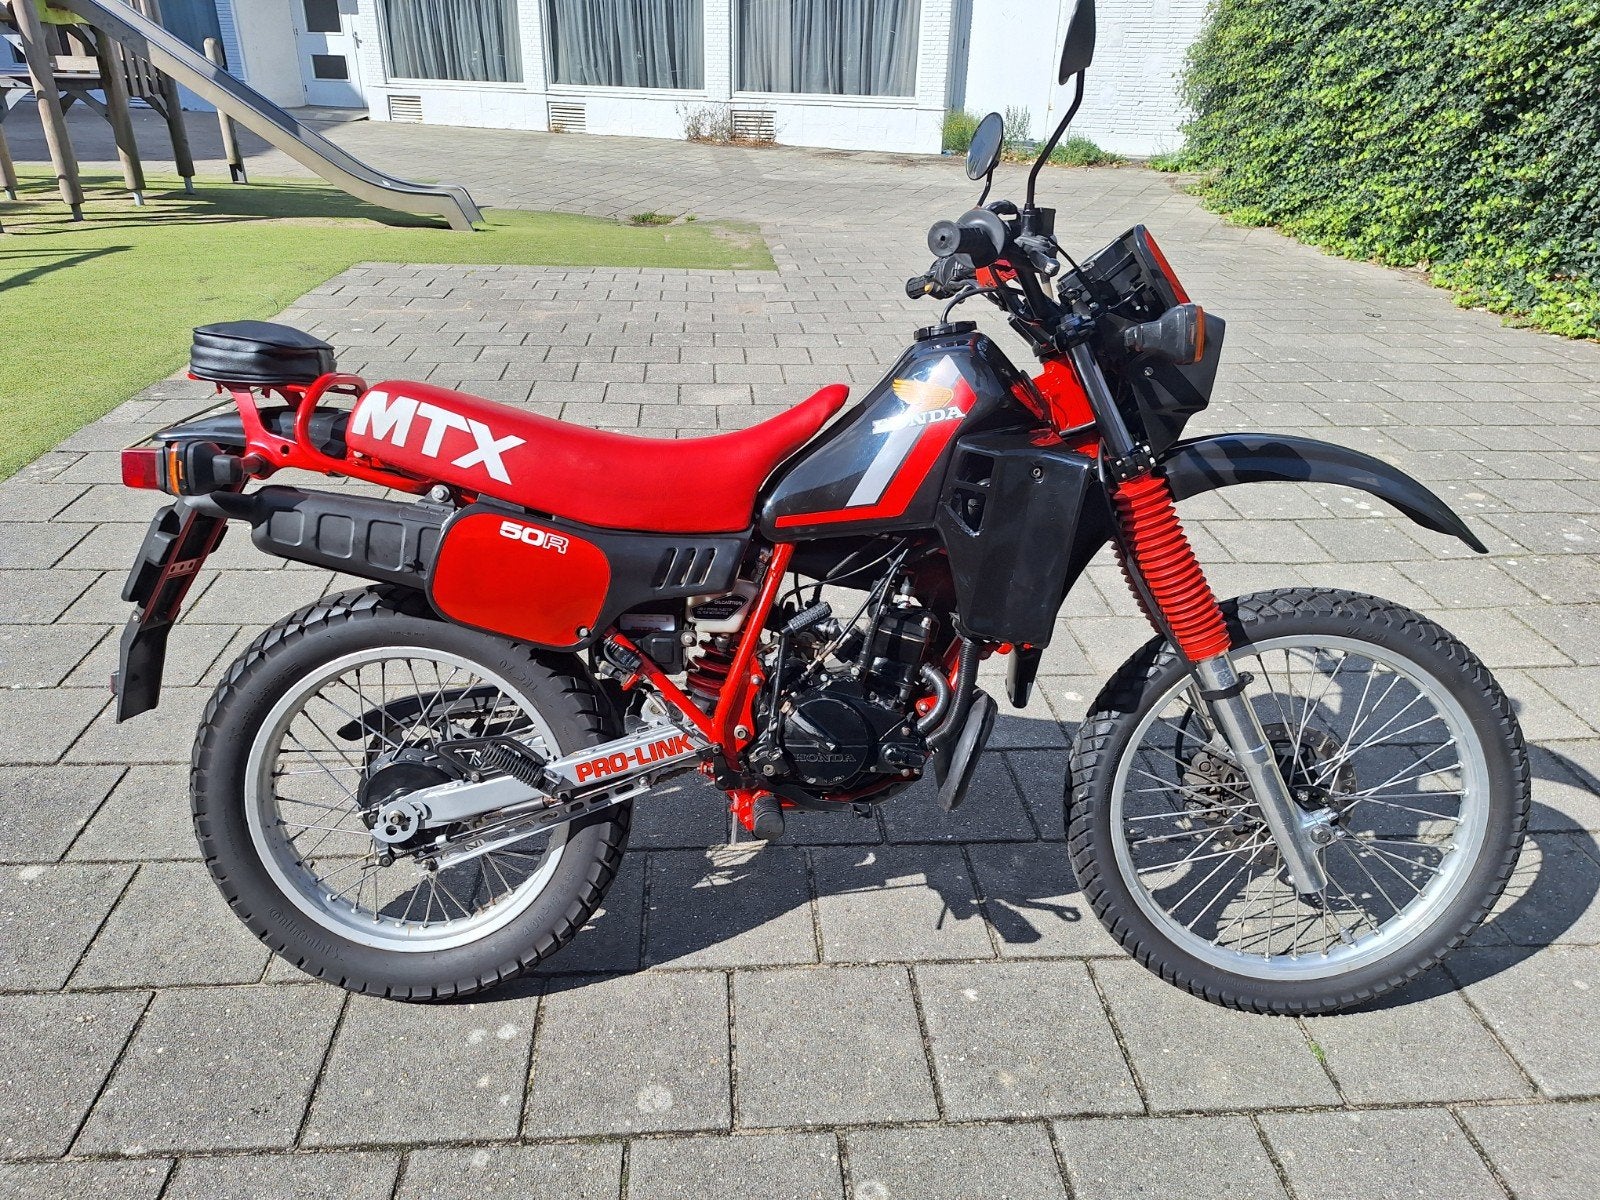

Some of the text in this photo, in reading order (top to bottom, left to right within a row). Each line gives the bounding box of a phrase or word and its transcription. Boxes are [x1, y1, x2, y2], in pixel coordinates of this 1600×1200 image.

[351, 390, 528, 485] MTX
[499, 520, 570, 555] 50R
[575, 732, 696, 783] PRO-LINK
[794, 752, 857, 763] HONDA
